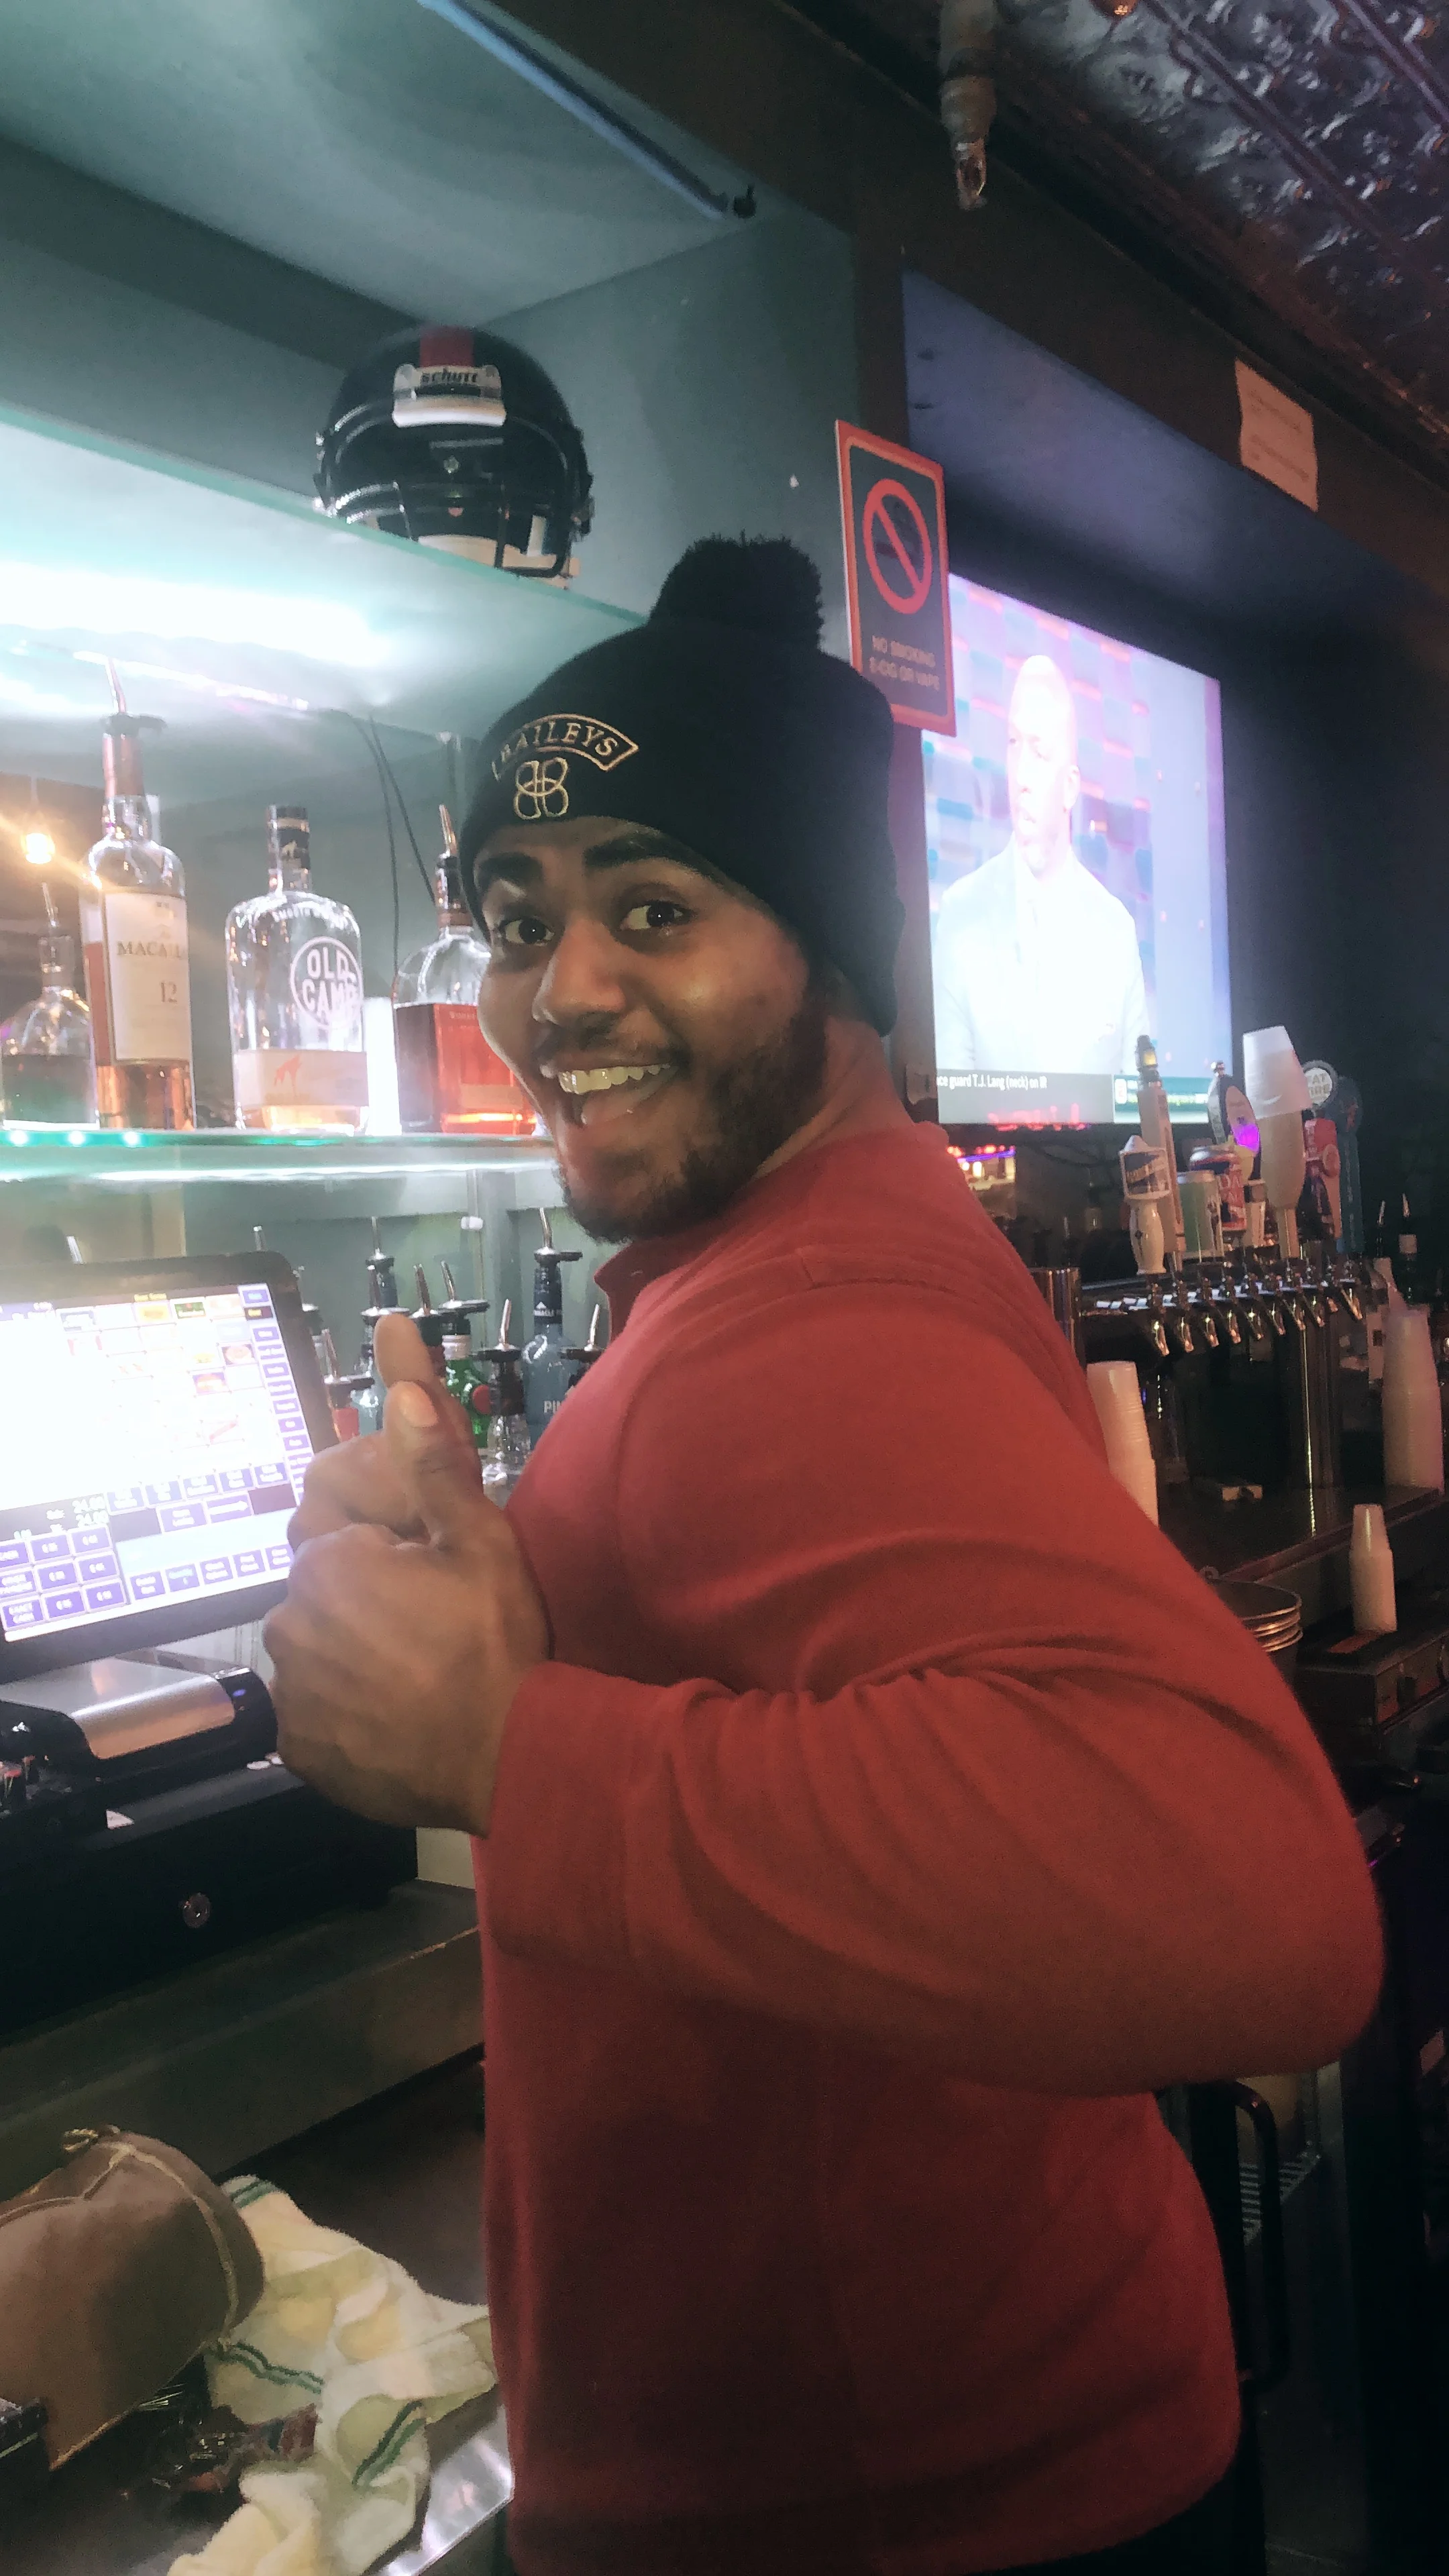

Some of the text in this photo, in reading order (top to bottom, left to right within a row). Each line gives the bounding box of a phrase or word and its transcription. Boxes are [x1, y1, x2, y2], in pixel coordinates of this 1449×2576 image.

[871, 635, 935, 667] NO SMOKING
[307, 947, 349, 979] OLD
[160, 981, 178, 1004] 12
[949, 1075, 972, 1090] guard
[987, 1075, 1006, 1091] Lang
